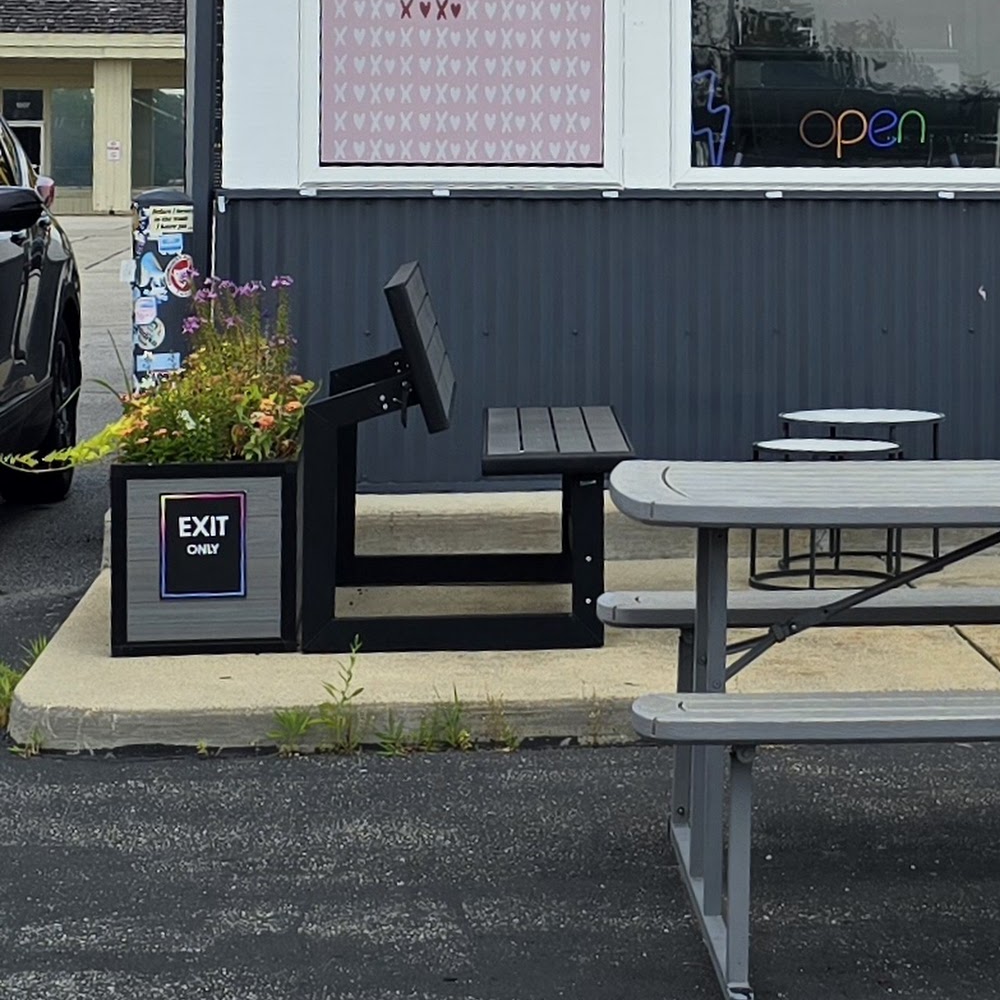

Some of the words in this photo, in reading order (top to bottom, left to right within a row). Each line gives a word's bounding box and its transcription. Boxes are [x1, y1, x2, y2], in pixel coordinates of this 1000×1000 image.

[799, 109, 927, 159] open
[178, 515, 230, 538] EXIT
[186, 542, 220, 556] ONLY
